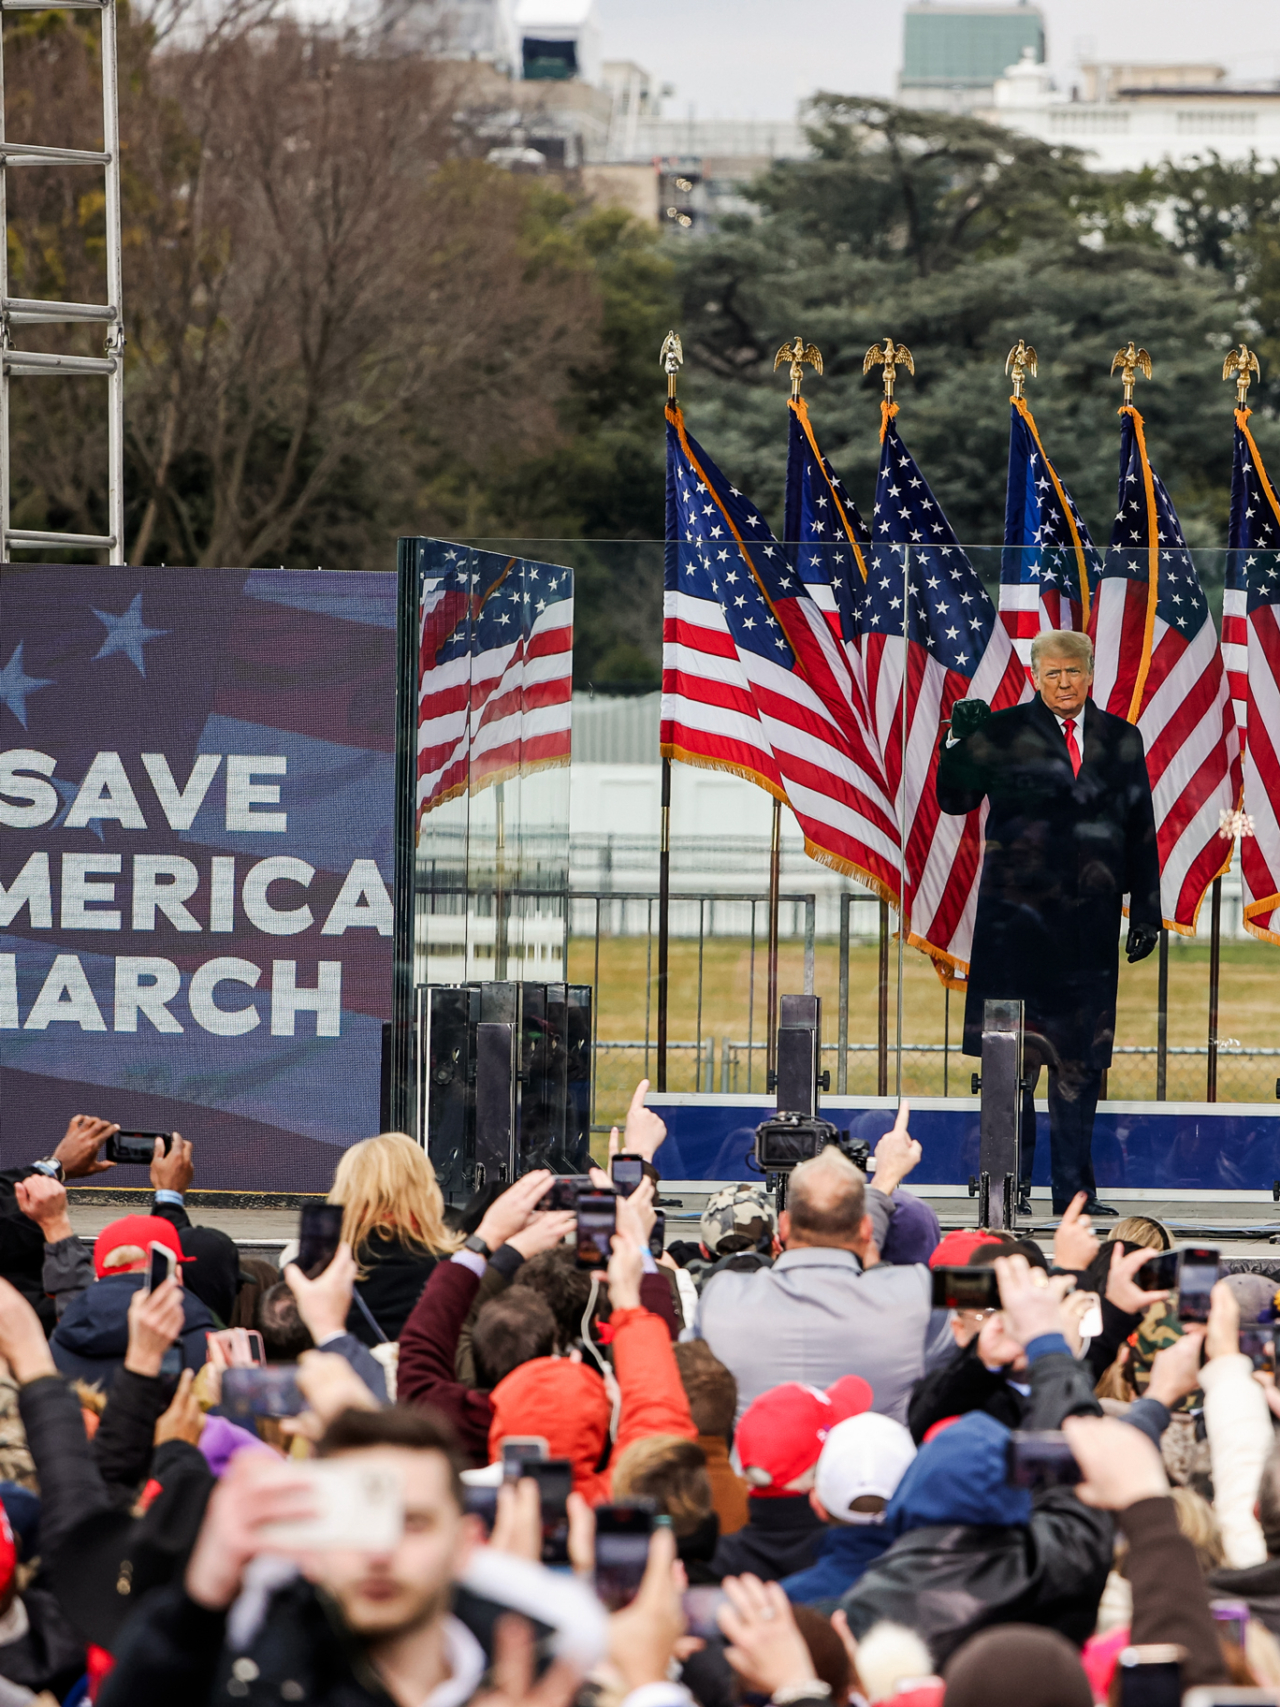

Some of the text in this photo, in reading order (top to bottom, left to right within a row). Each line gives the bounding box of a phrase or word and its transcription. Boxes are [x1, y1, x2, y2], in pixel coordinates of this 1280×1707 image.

[0, 749, 287, 832] SAVE
[0, 851, 394, 935] MERICA
[0, 953, 342, 1037] ARCH
